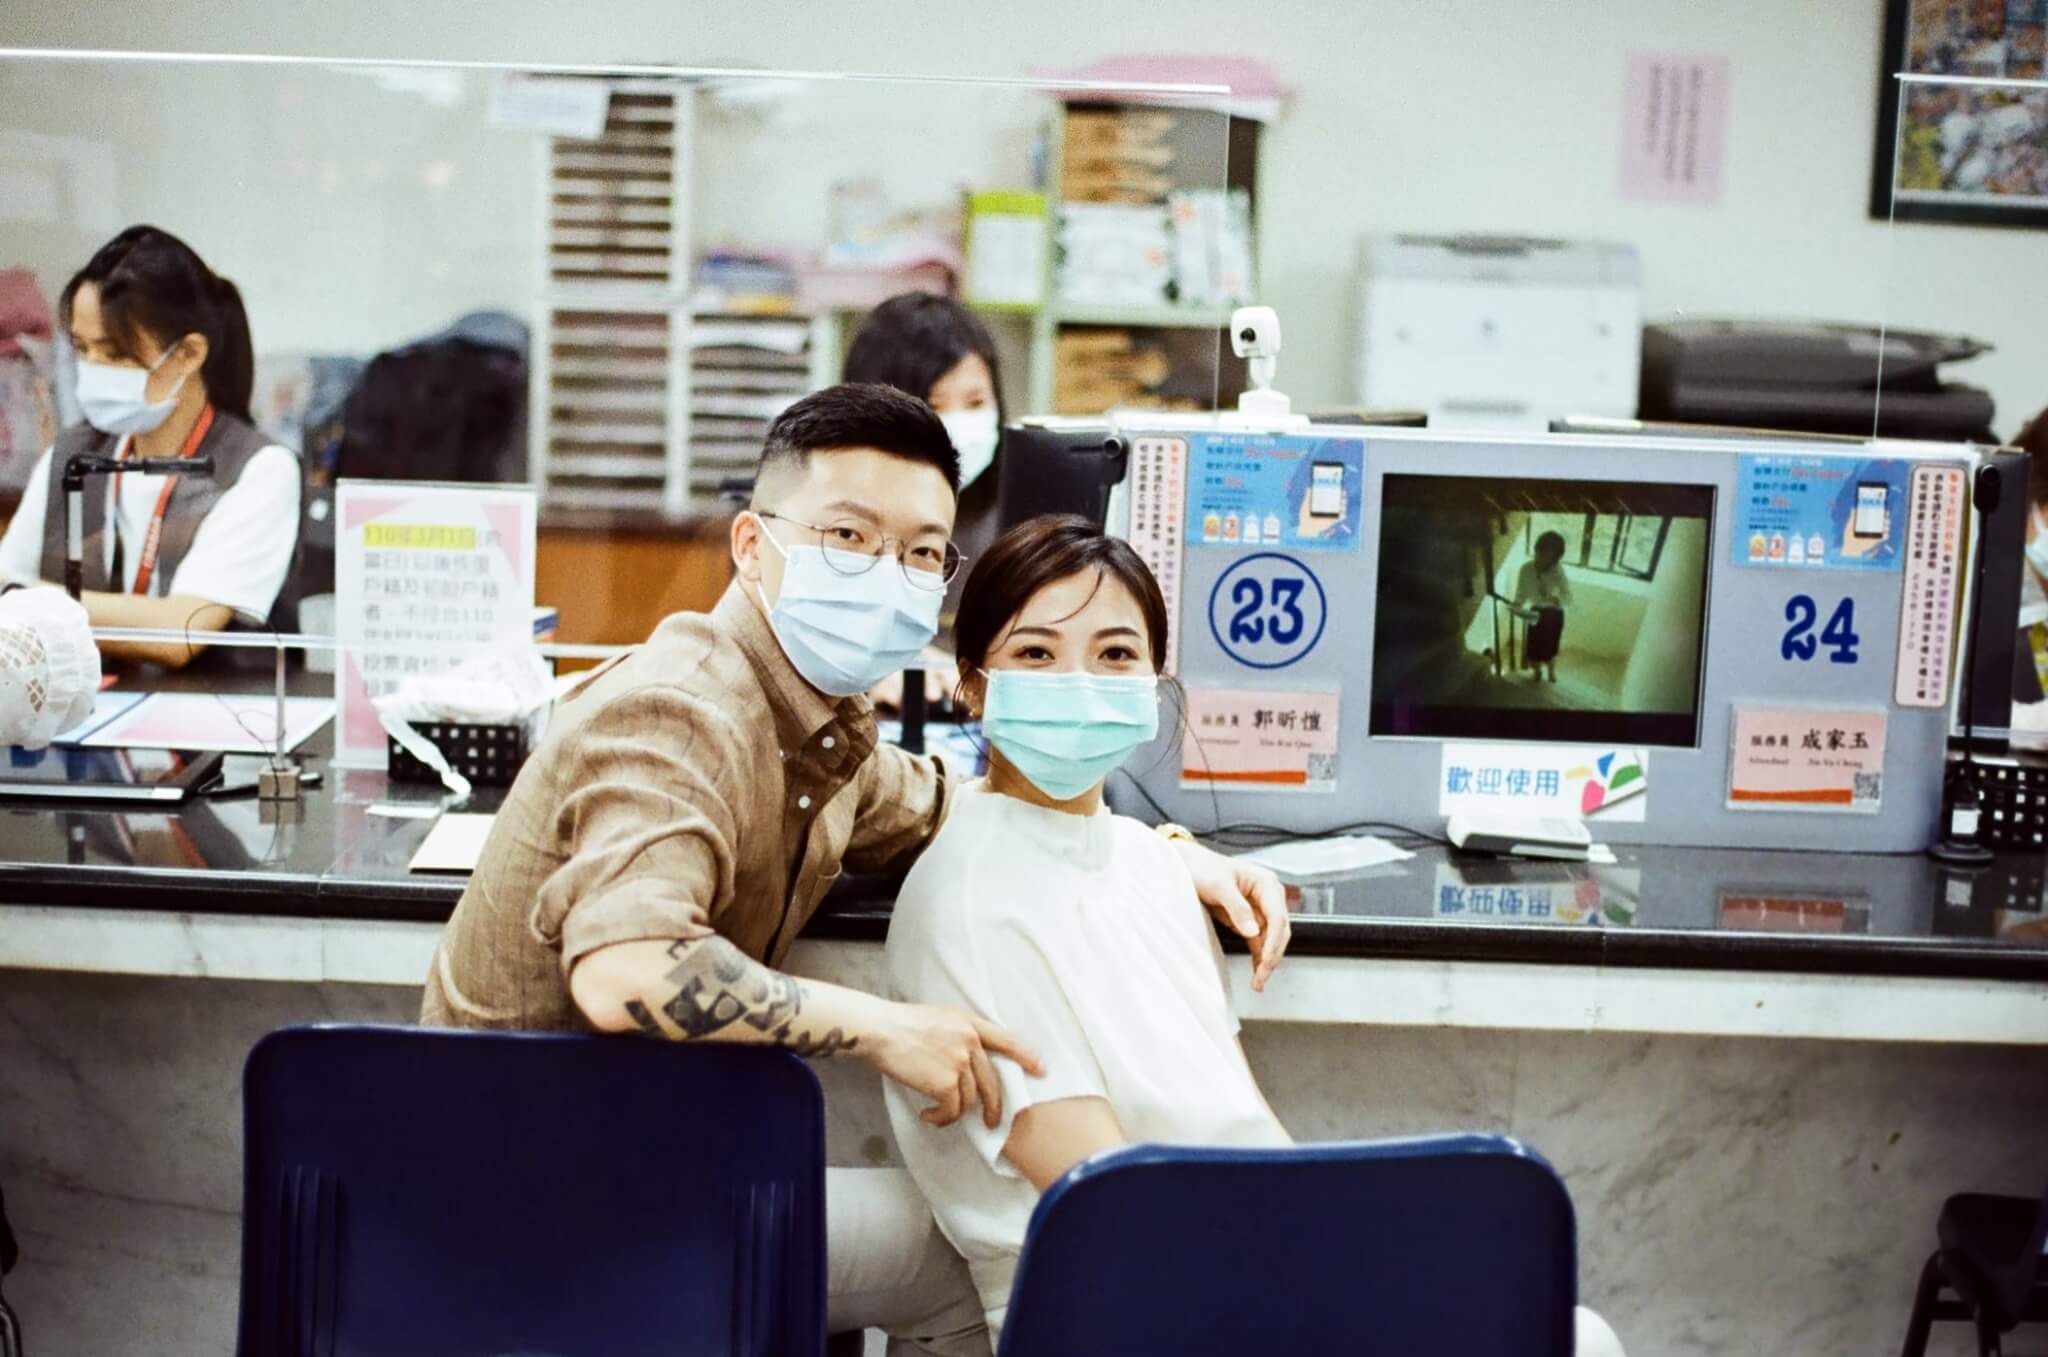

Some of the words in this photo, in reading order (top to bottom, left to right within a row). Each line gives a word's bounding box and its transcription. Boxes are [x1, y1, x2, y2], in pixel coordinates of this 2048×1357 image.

[1230, 578, 1305, 645] 23
[1781, 594, 1860, 664] 24
[1447, 766, 1559, 797] 歡迎使用
